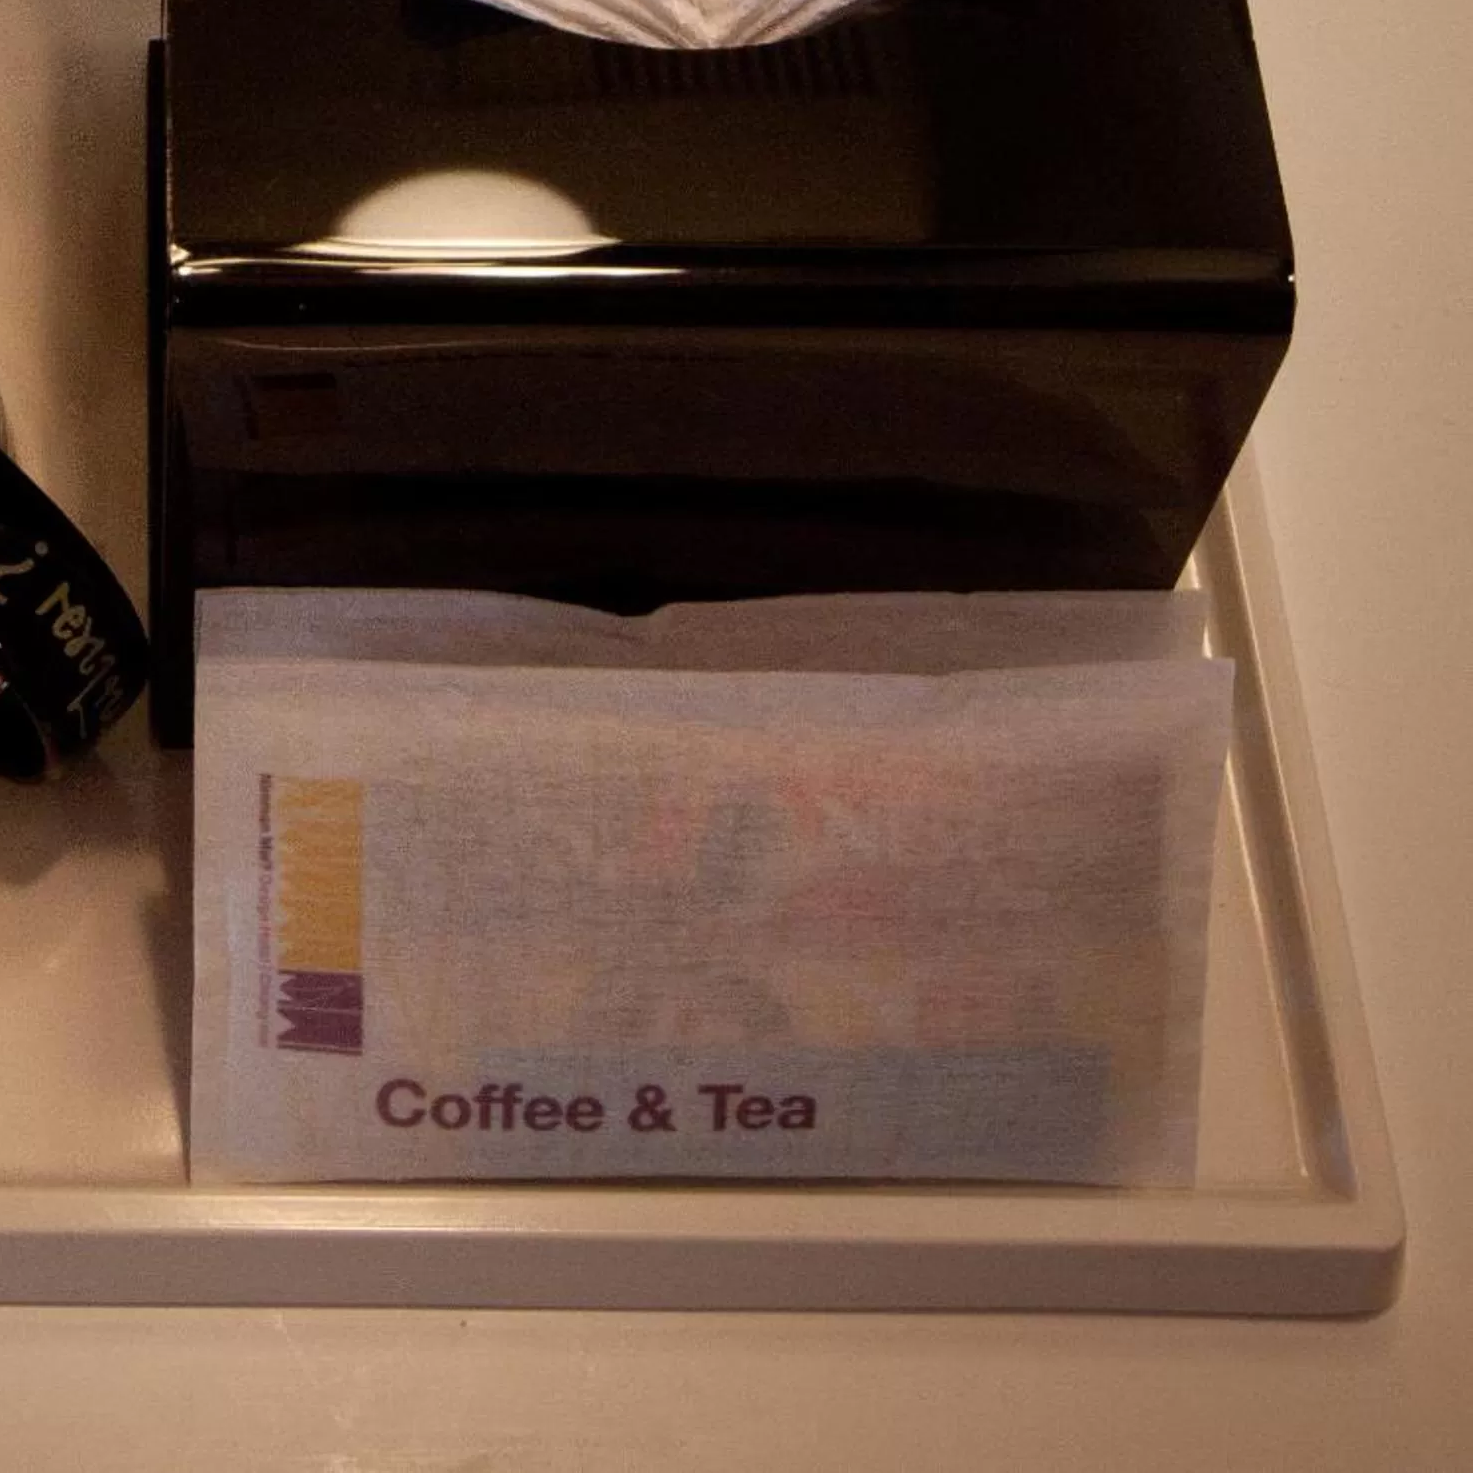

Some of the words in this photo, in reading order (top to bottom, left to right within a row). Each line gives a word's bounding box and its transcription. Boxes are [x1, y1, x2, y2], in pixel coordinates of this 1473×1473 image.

[375, 1077, 607, 1133] Coffee
[627, 1084, 677, 1132] &
[699, 1083, 819, 1133] Tea
